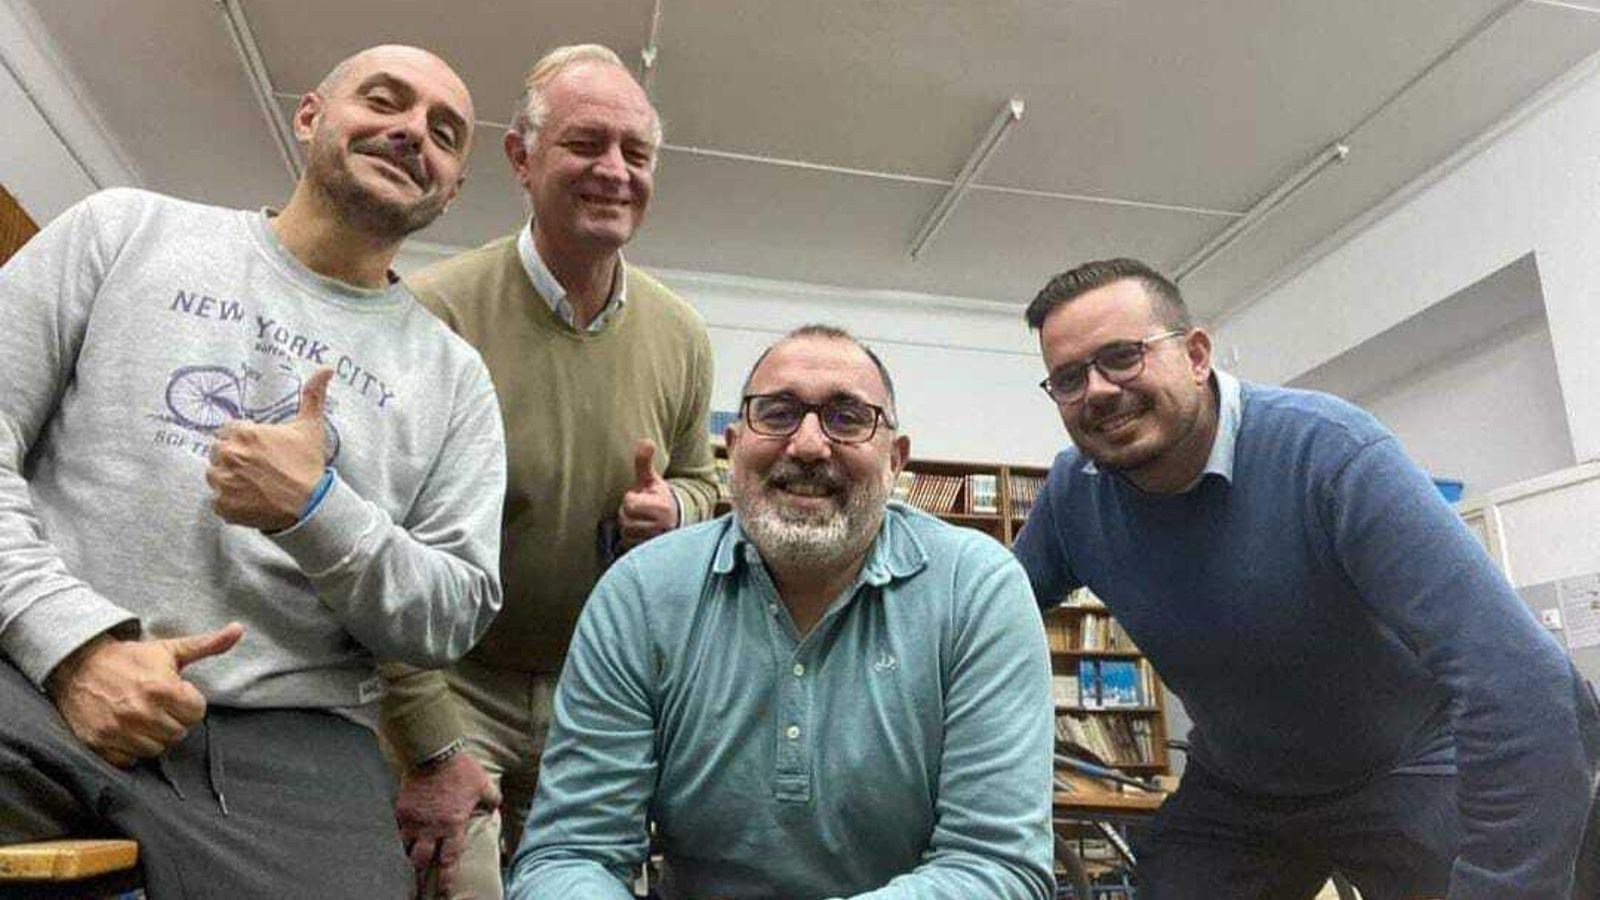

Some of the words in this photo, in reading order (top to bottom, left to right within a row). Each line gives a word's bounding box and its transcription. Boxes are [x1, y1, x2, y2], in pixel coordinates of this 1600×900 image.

[171, 290, 244, 322] NEW
[255, 316, 329, 364] YORK
[337, 355, 394, 408] CITY
